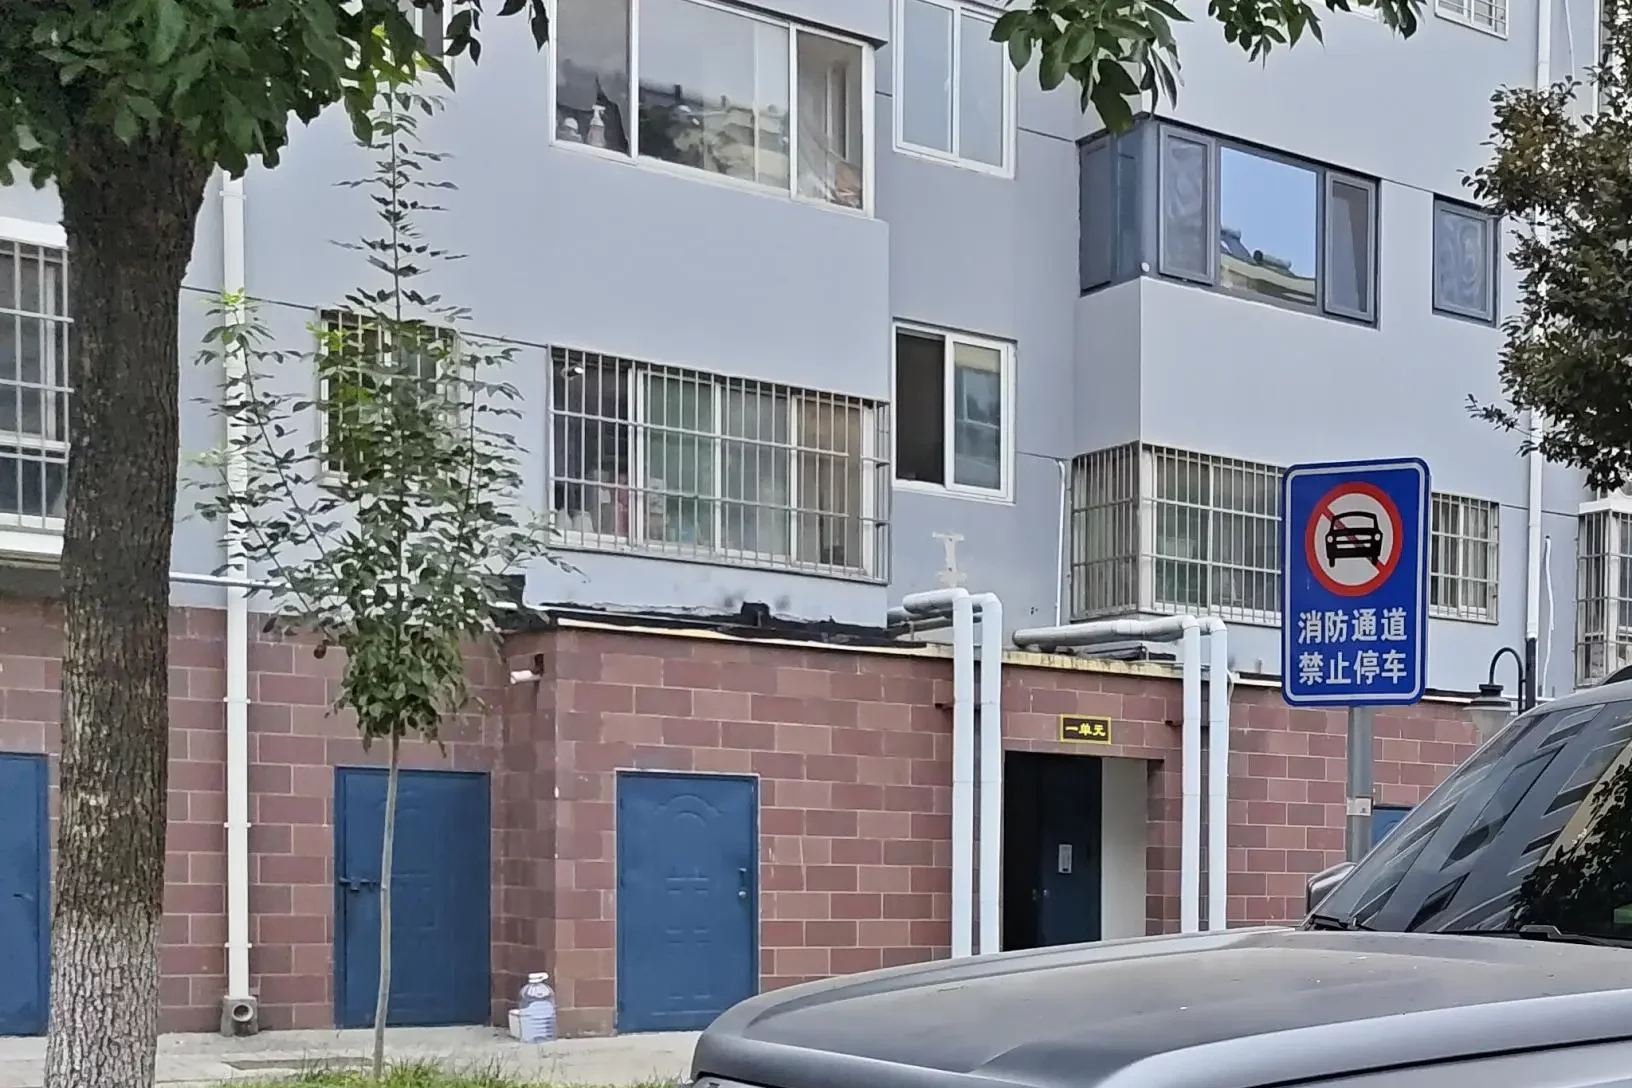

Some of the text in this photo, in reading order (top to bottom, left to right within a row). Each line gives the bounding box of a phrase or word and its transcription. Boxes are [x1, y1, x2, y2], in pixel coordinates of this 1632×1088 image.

[1298, 607, 1407, 644] 消防通道
[1299, 649, 1407, 686] 禁止停车
[1065, 722, 1106, 737] 一单元
